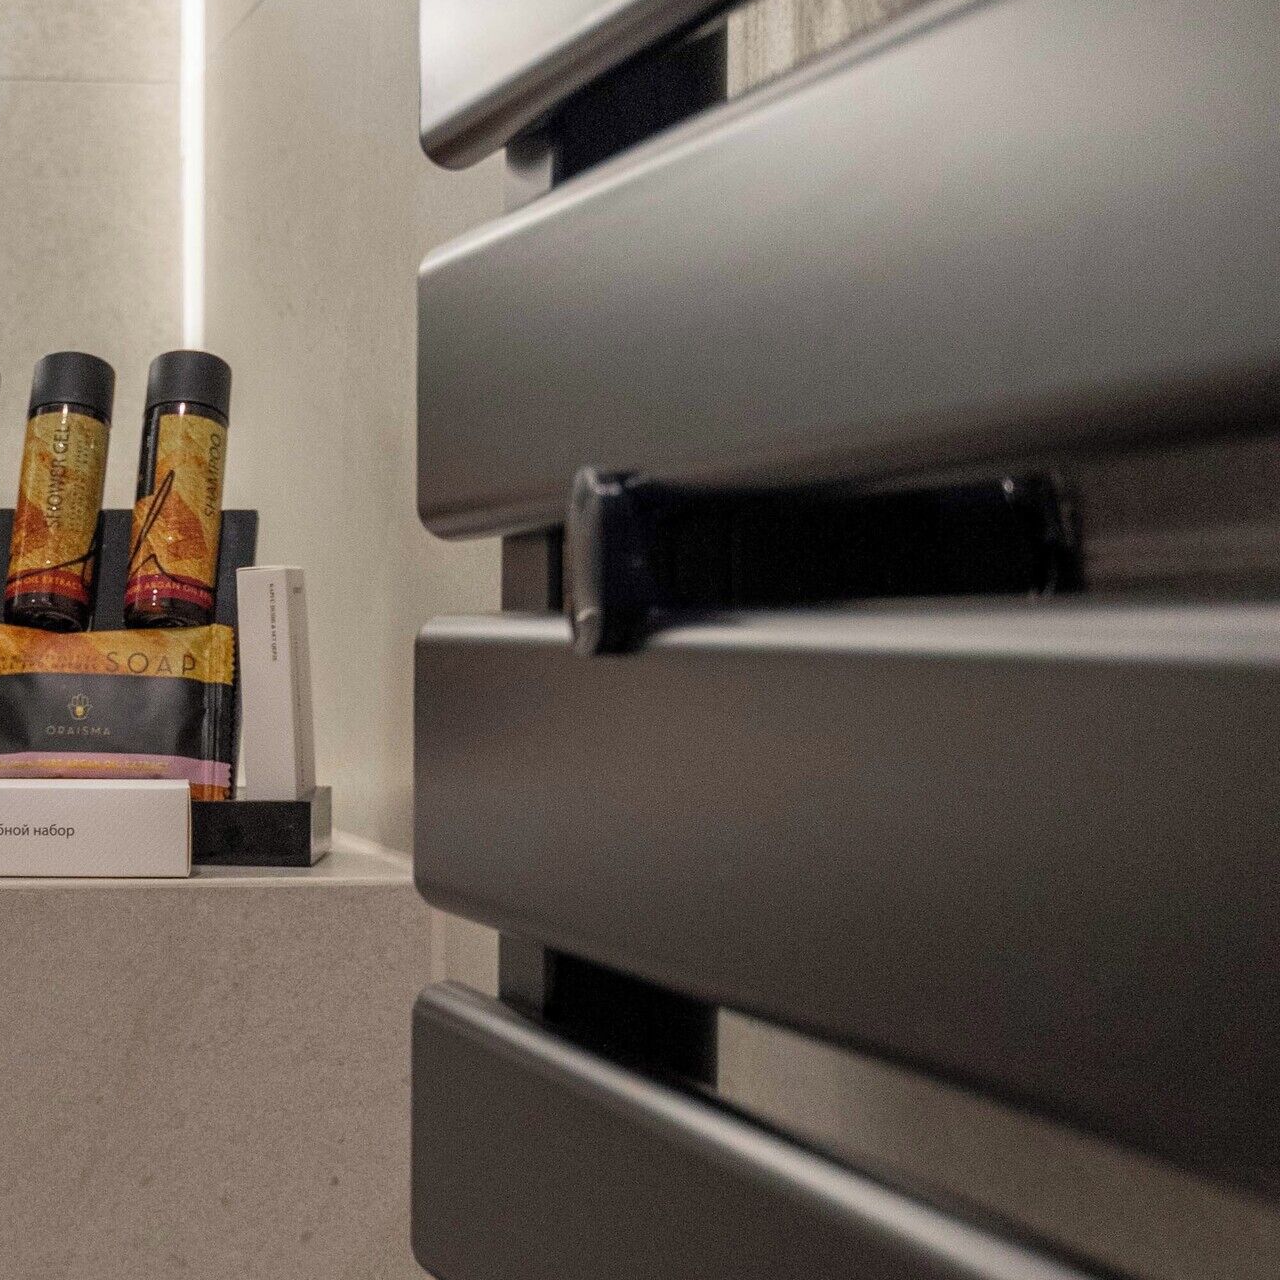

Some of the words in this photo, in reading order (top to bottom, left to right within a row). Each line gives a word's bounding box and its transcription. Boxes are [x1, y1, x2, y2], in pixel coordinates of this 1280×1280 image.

[51, 424, 70, 456] GEL
[203, 432, 223, 519] SHAMPOO
[45, 458, 67, 530] SHOWER
[105, 651, 197, 675] SOAP
[45, 724, 112, 737] ORAISMA
[33, 824, 75, 838] набор
